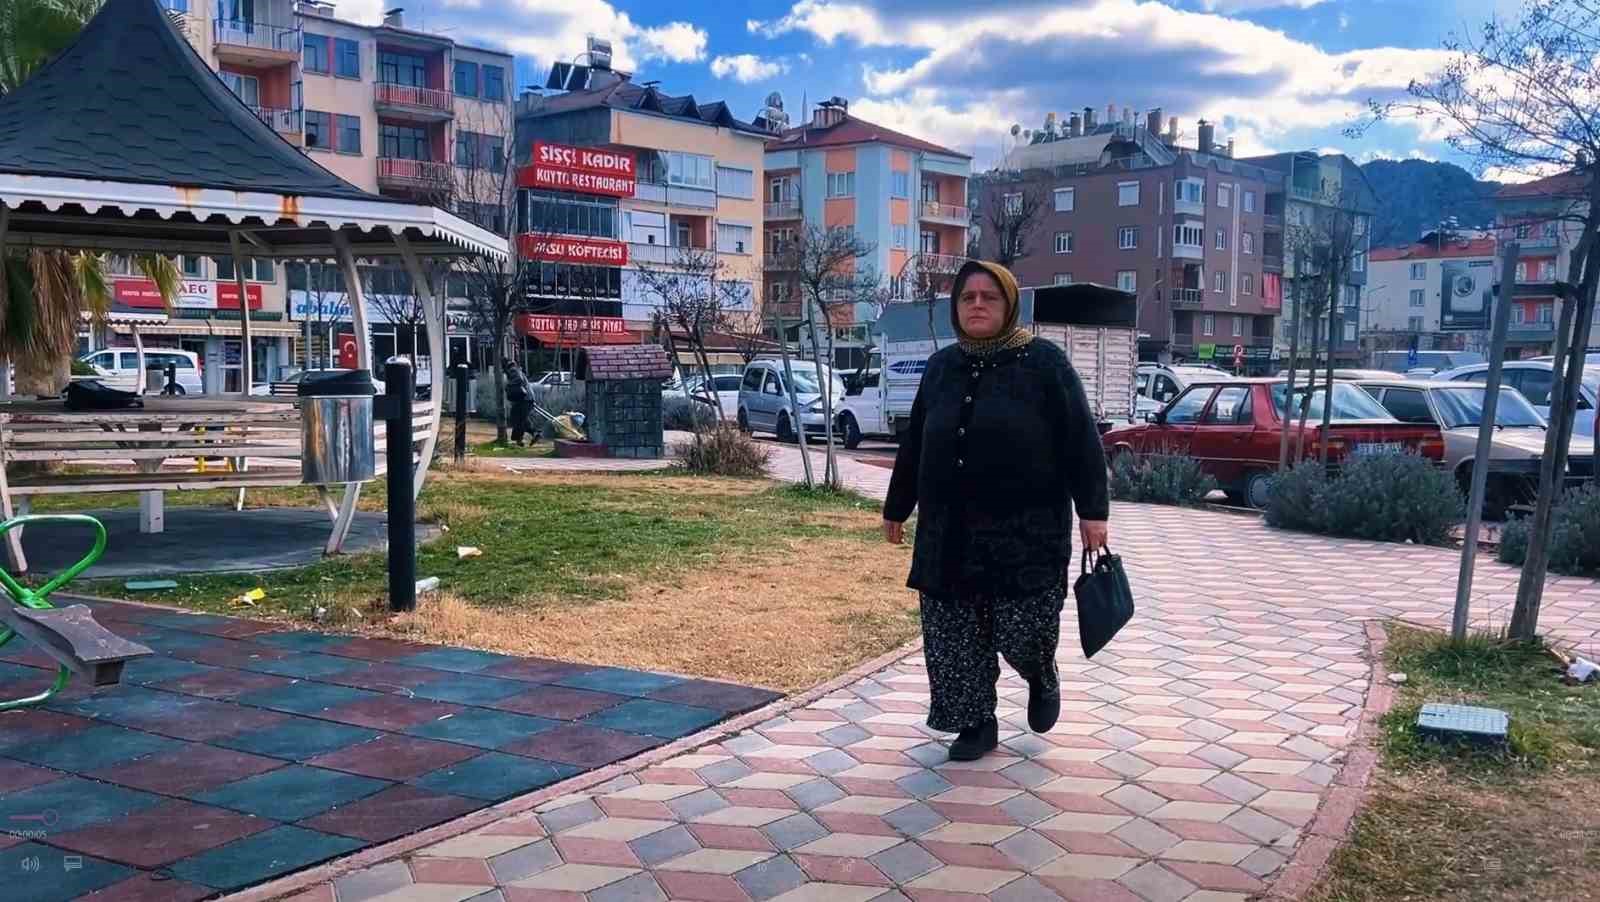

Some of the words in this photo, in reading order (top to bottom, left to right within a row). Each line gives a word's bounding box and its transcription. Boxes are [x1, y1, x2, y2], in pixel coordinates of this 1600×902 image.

[582, 151, 631, 172] KADİR
[572, 172, 635, 193] RESTAURANT
[567, 242, 623, 260] KÖFTECİSİ
